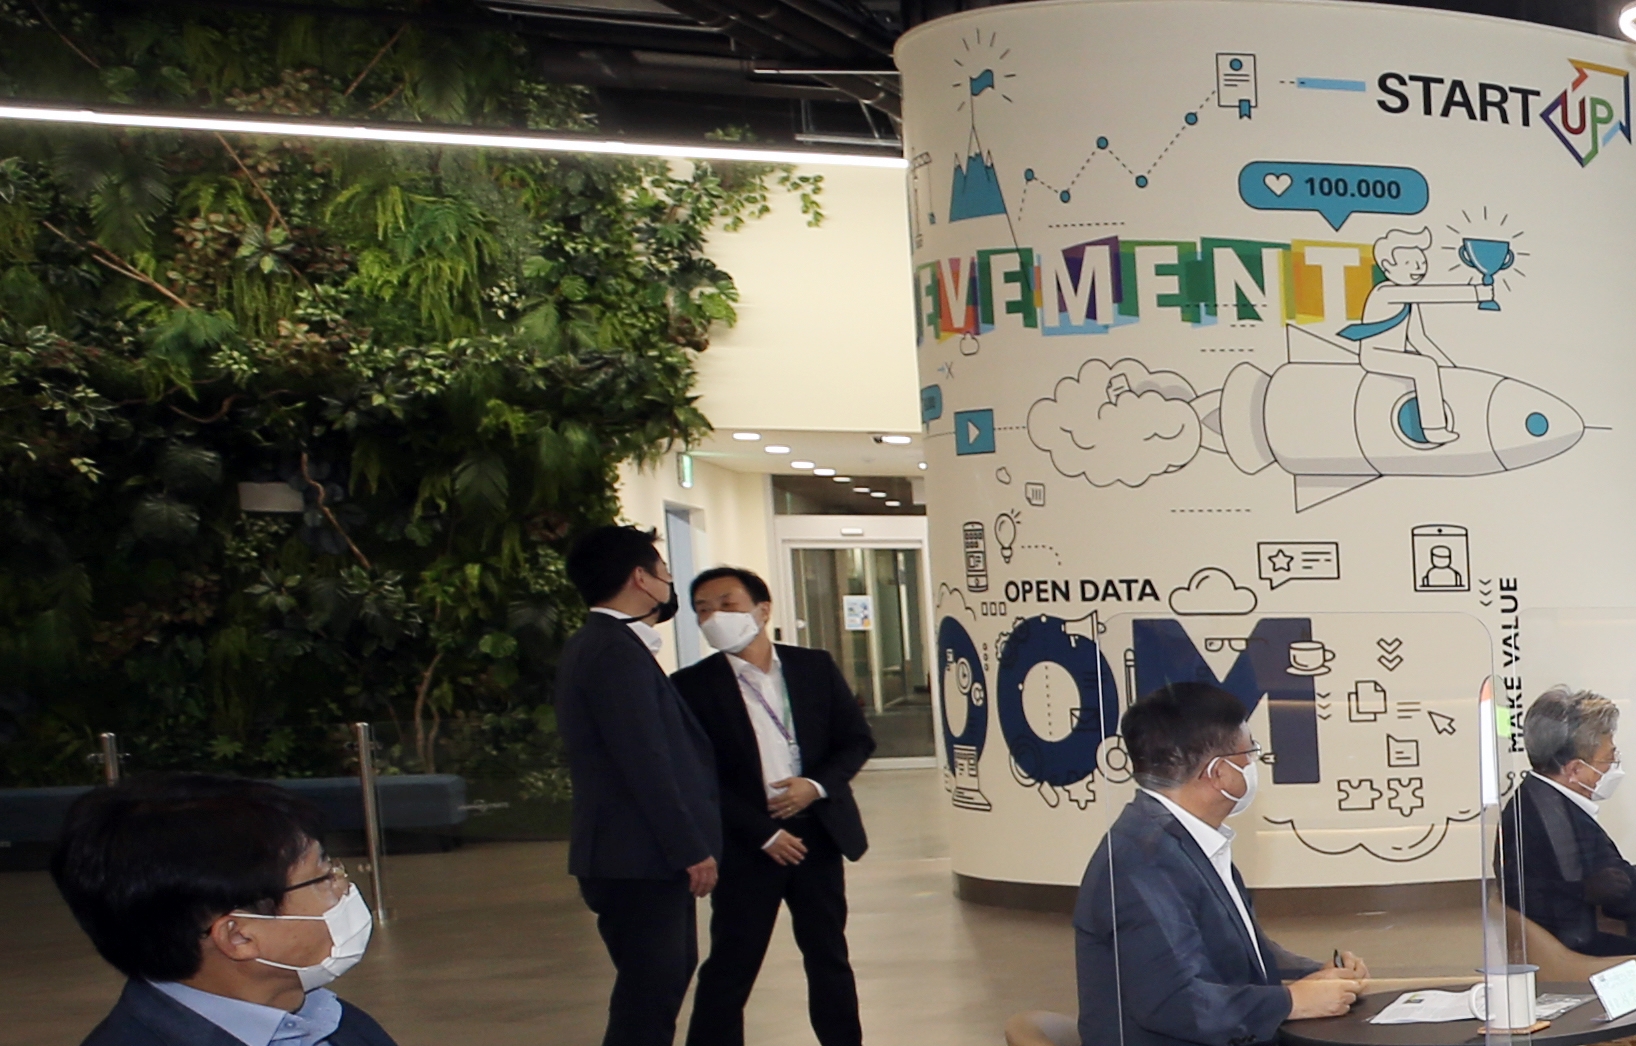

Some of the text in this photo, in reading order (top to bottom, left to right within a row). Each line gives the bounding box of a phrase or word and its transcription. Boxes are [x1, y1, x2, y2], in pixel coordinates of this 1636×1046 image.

[1376, 71, 1541, 127] START
[1560, 88, 1614, 151] UP
[1304, 177, 1402, 200] 100.000
[1004, 578, 1160, 603] OPEN DATA
[1499, 577, 1525, 754] MAKE VALUE
